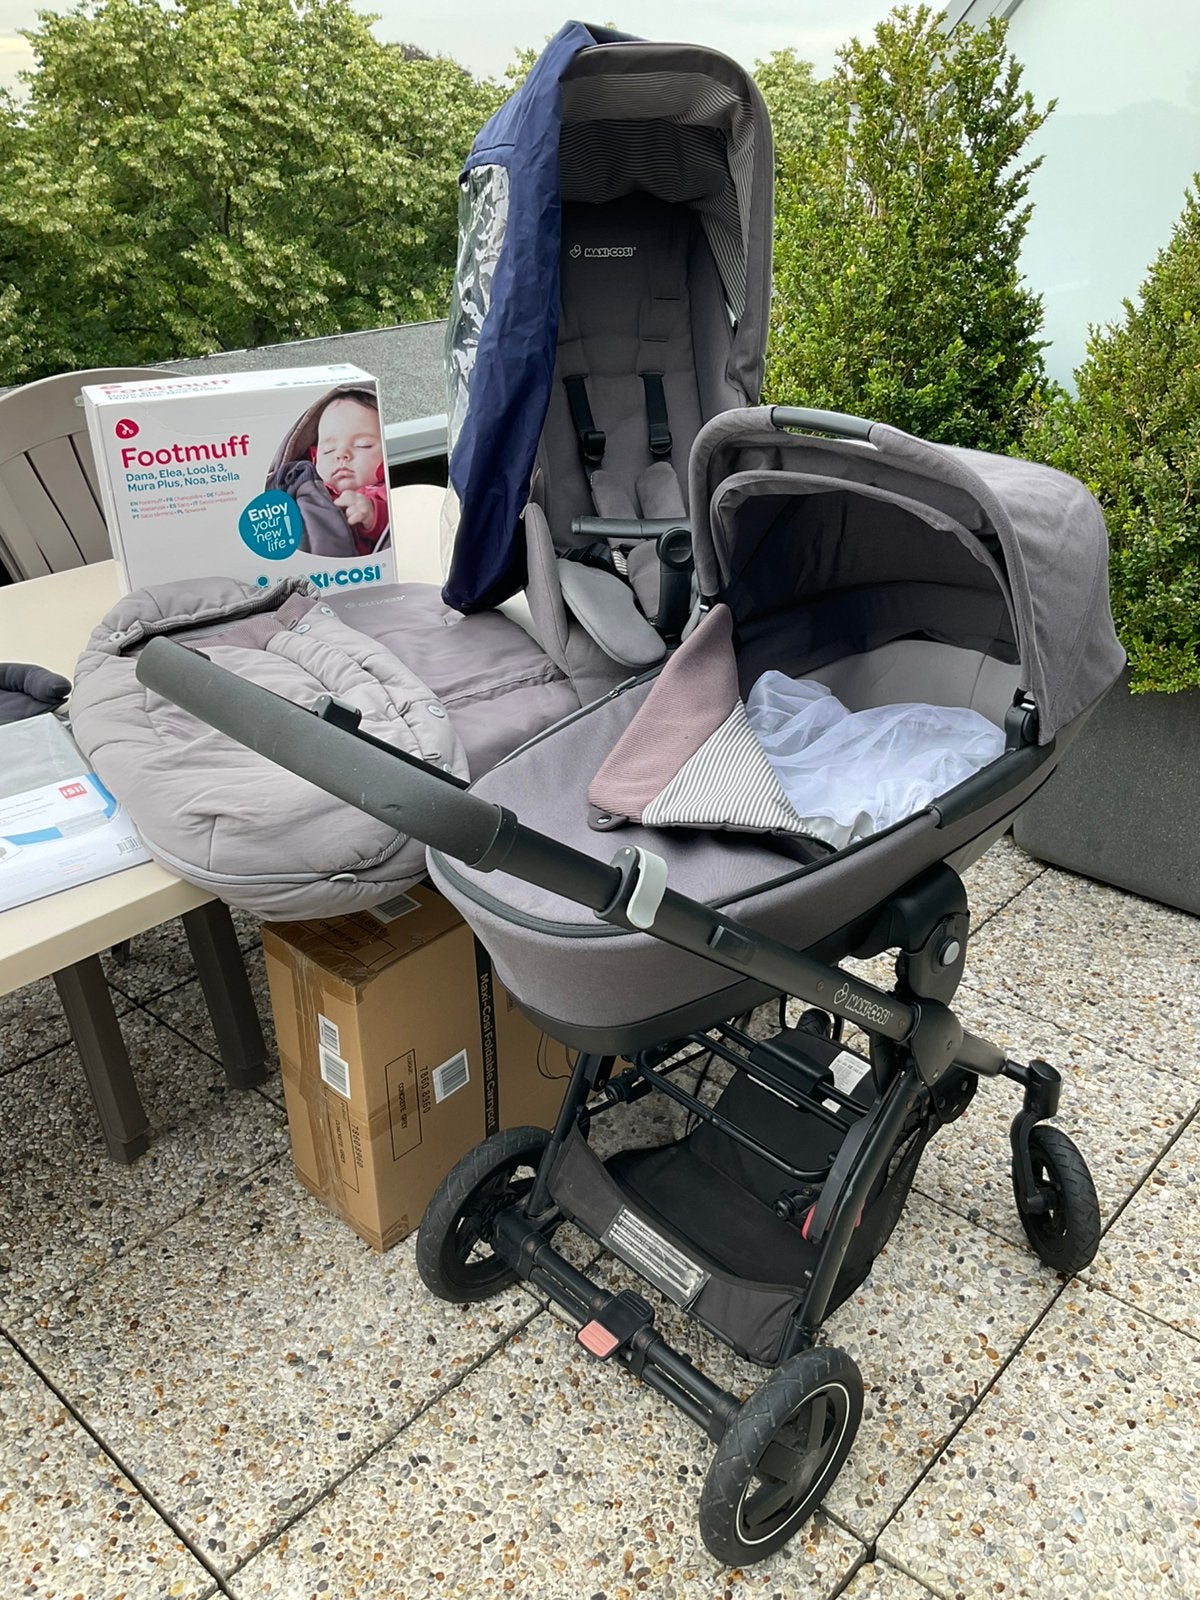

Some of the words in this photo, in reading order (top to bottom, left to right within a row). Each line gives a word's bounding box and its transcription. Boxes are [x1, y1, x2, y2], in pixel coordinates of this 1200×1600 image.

[121, 434, 250, 469] Footmuff
[126, 473, 158, 482] Dana,
[159, 469, 186, 480] Elea,
[186, 464, 216, 476] Loola
[127, 482, 156, 492] Mura
[157, 479, 183, 489] Plus,
[184, 475, 209, 486] Noa,
[210, 472, 240, 484] Stella
[248, 502, 287, 522] Enjoy
[252, 516, 280, 536] your
[256, 527, 282, 543] new
[267, 538, 286, 552] life
[480, 972, 494, 1032] Maxi-Cosi
[484, 1031, 495, 1080] Foldable
[486, 1080, 497, 1130] Carrycot
